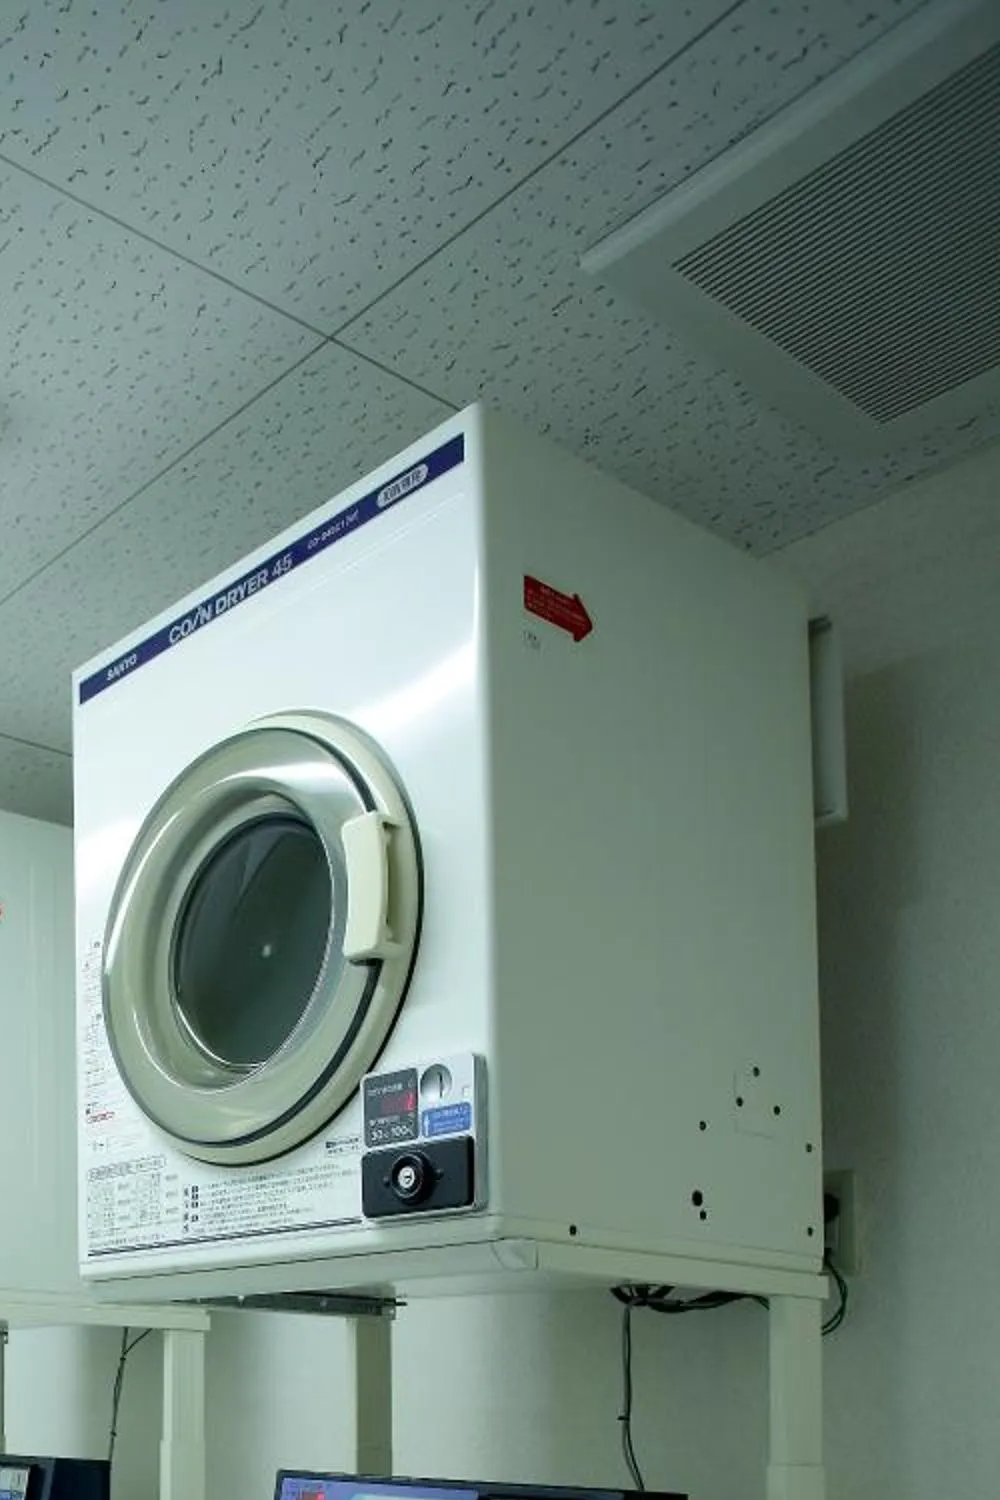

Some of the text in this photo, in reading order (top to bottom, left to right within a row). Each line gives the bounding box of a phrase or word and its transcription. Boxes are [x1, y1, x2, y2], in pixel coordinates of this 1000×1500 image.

[107, 653, 137, 681] SANYO
[215, 570, 268, 614] DRYER
[272, 553, 293, 577] 45
